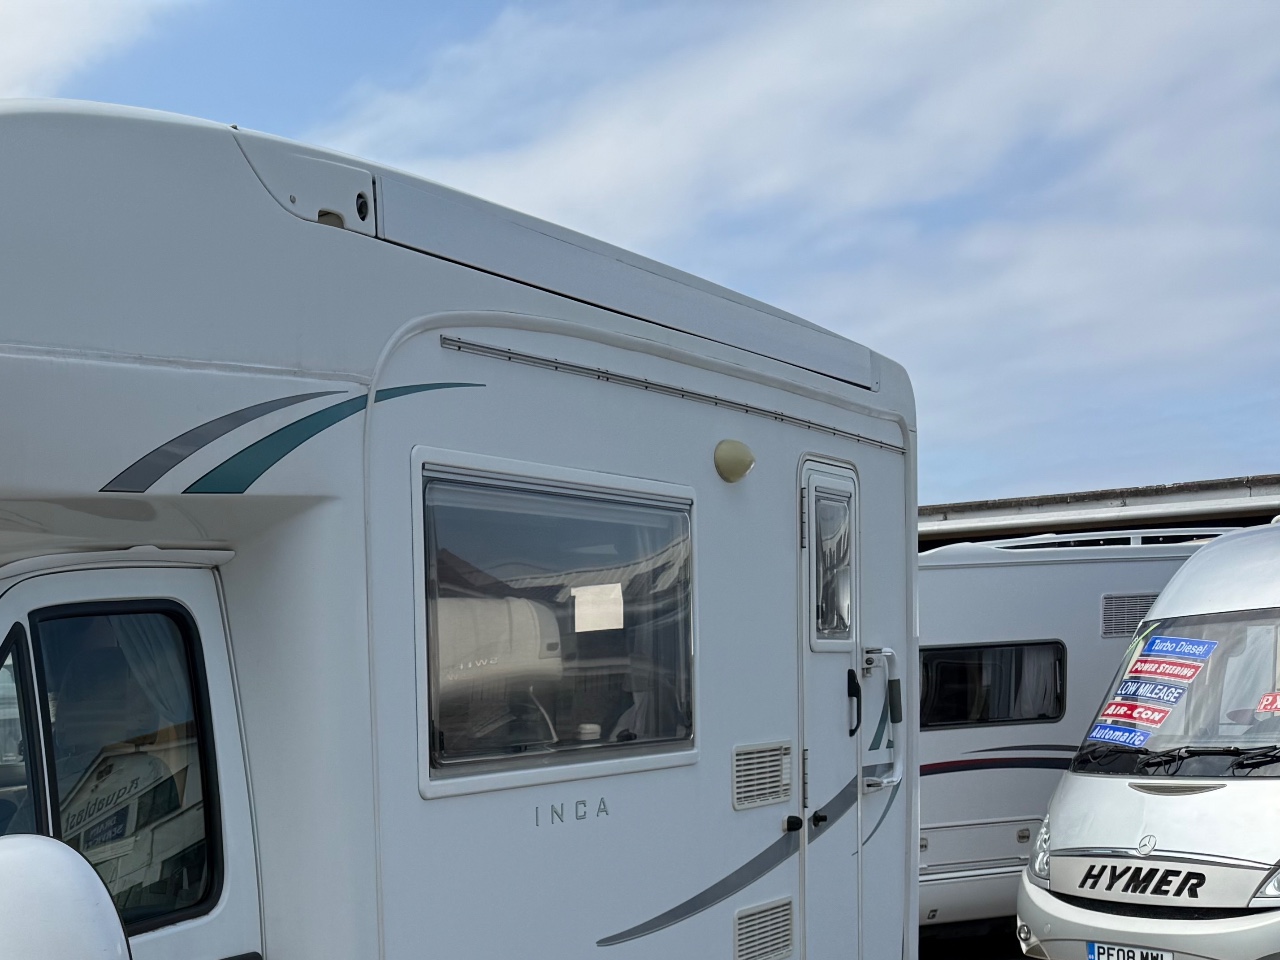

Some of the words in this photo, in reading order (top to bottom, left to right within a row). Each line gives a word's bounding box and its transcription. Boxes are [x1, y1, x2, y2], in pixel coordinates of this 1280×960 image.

[1152, 639, 1175, 652] Turbo
[1175, 641, 1208, 655] Diesel
[1133, 661, 1159, 672] POWER
[1157, 663, 1196, 677] STEERING
[1117, 681, 1138, 695] LOW
[1137, 684, 1183, 702] MILEAGE
[1104, 704, 1165, 721] AIR-CON
[1091, 725, 1145, 745] Automatic
[535, 797, 609, 827] INCA
[1078, 864, 1206, 899] HYMER
